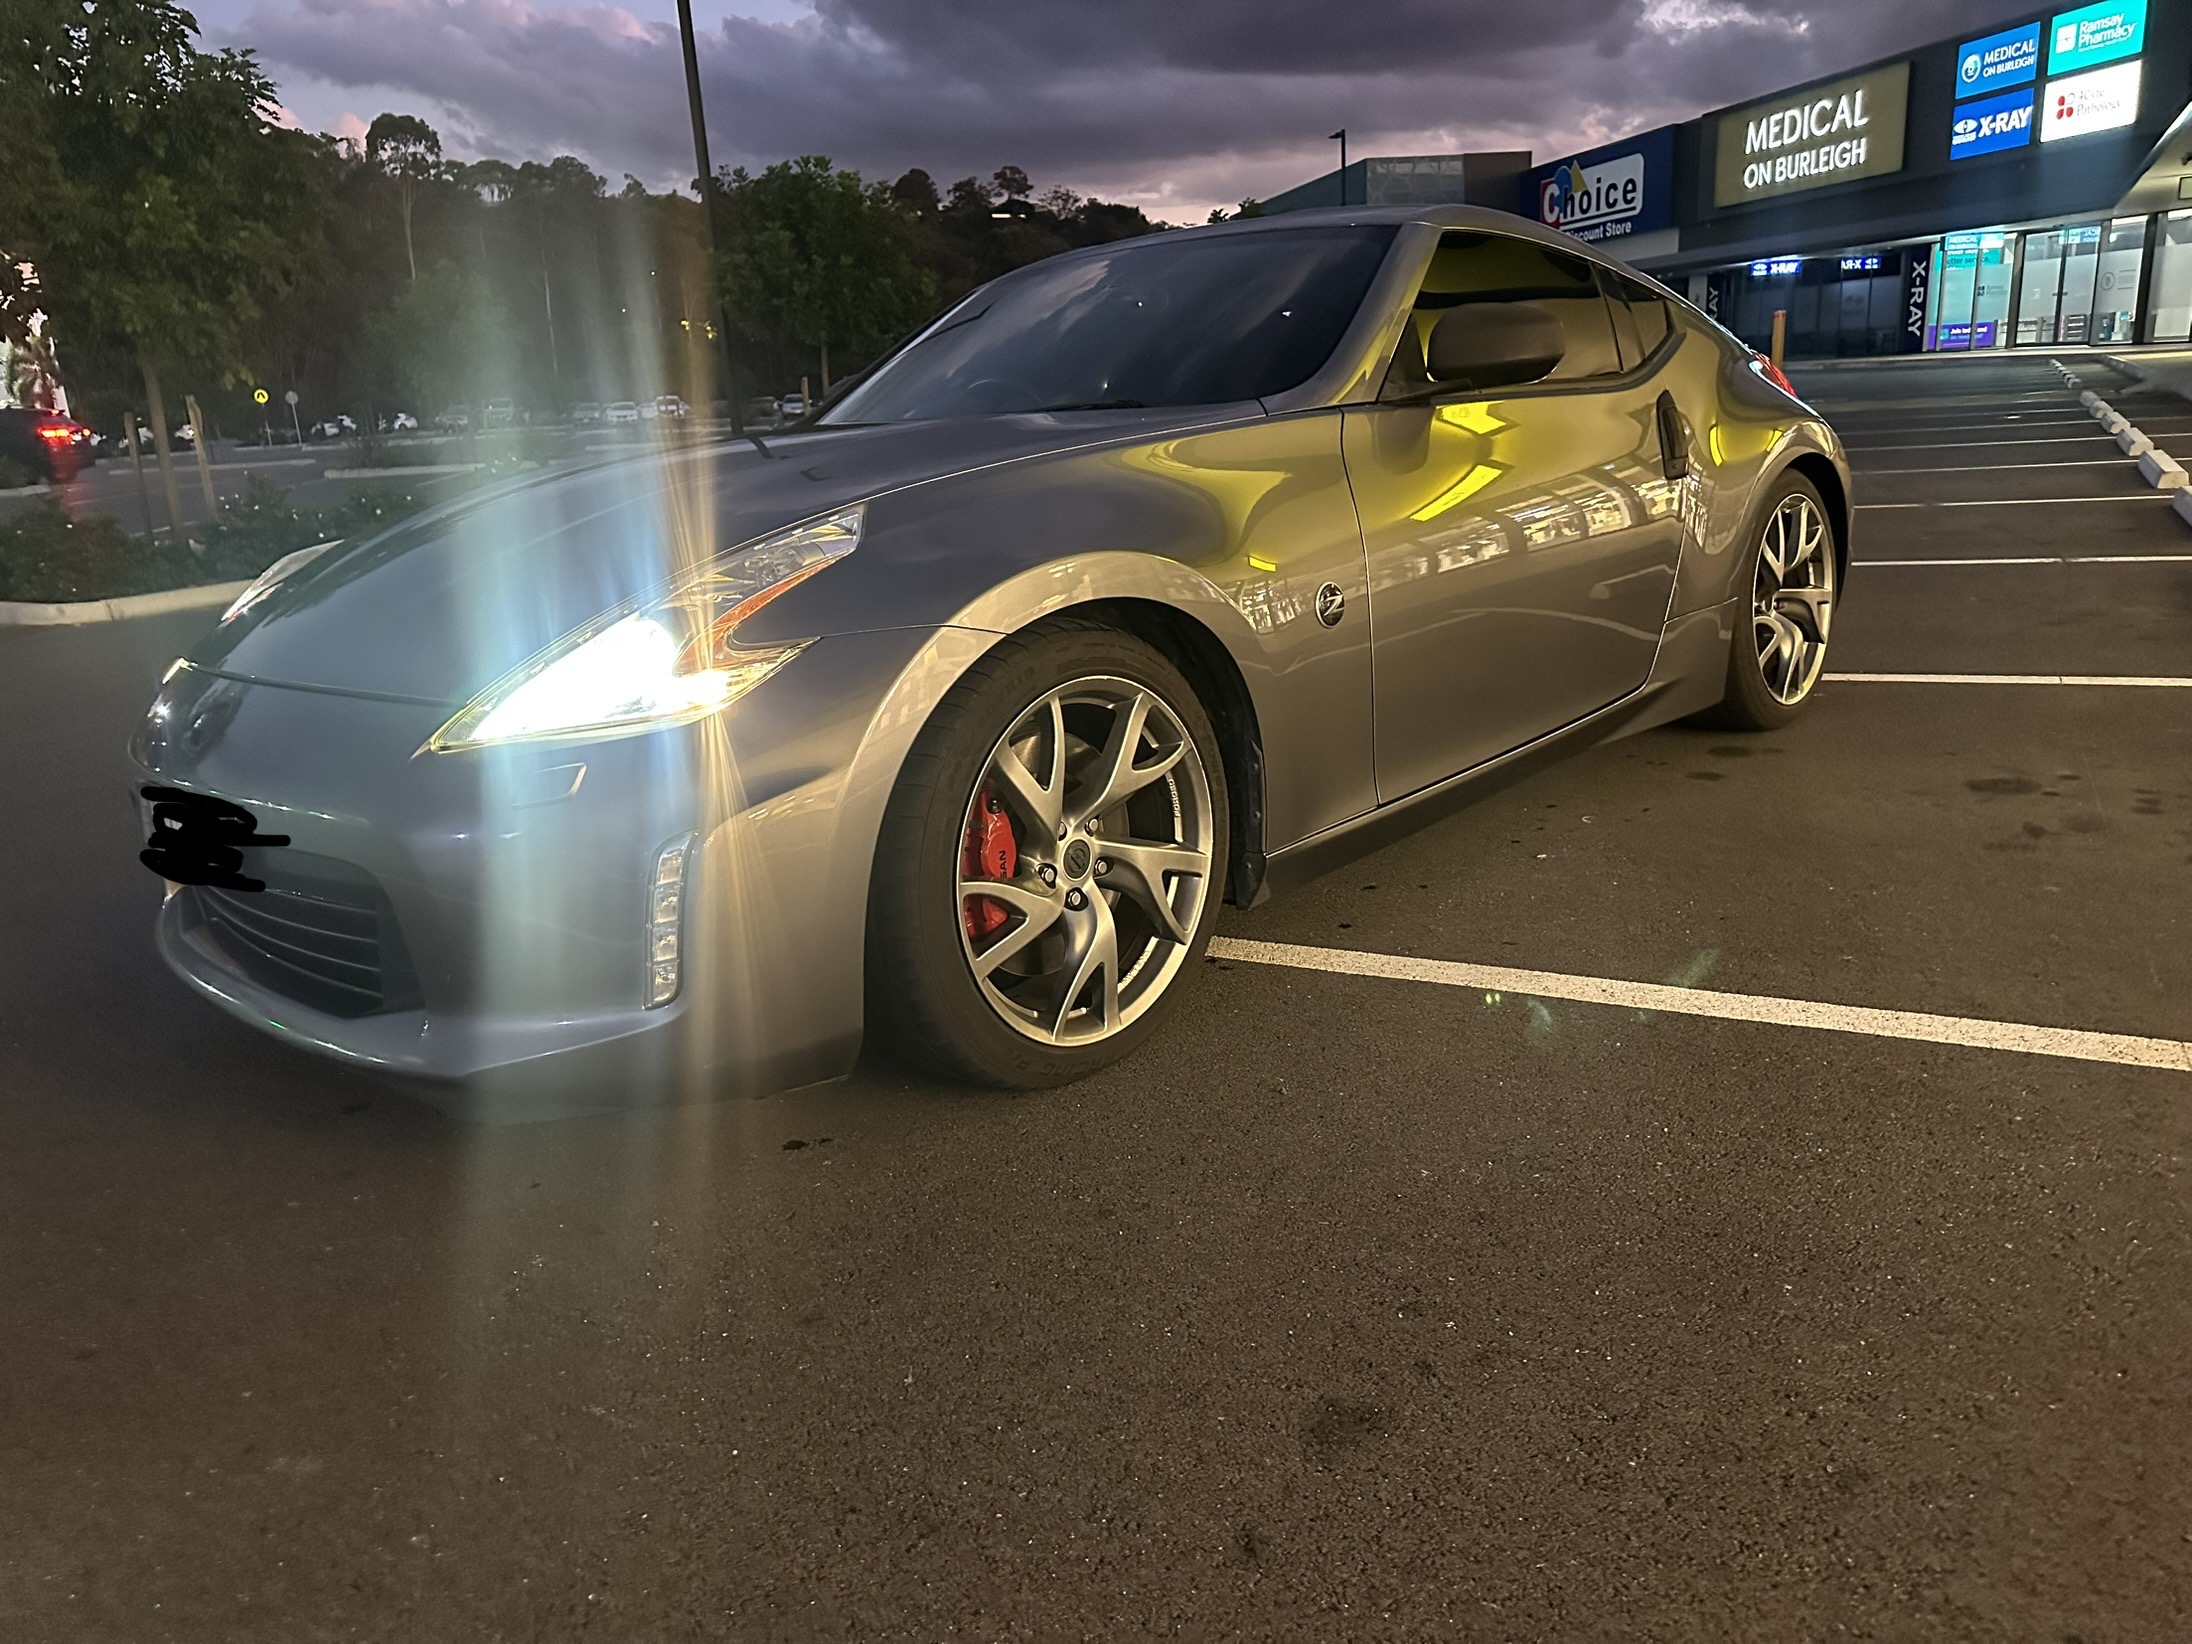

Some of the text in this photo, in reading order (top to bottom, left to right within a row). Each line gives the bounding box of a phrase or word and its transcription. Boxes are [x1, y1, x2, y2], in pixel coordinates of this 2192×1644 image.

[2078, 22, 2138, 47] Pharmacy
[2079, 13, 2125, 35] Ramsay
[1983, 55, 2035, 78] ON BURLEIGH
[1984, 39, 2036, 65] MEDICAL
[1744, 89, 1869, 155] MEDICAL
[1978, 105, 2034, 138] X-RAY
[1743, 137, 1867, 189] ON BURLEIGH
[1543, 177, 1637, 224] Choice
[1605, 221, 1632, 237] Store
[1907, 261, 1927, 337] X-RAY
